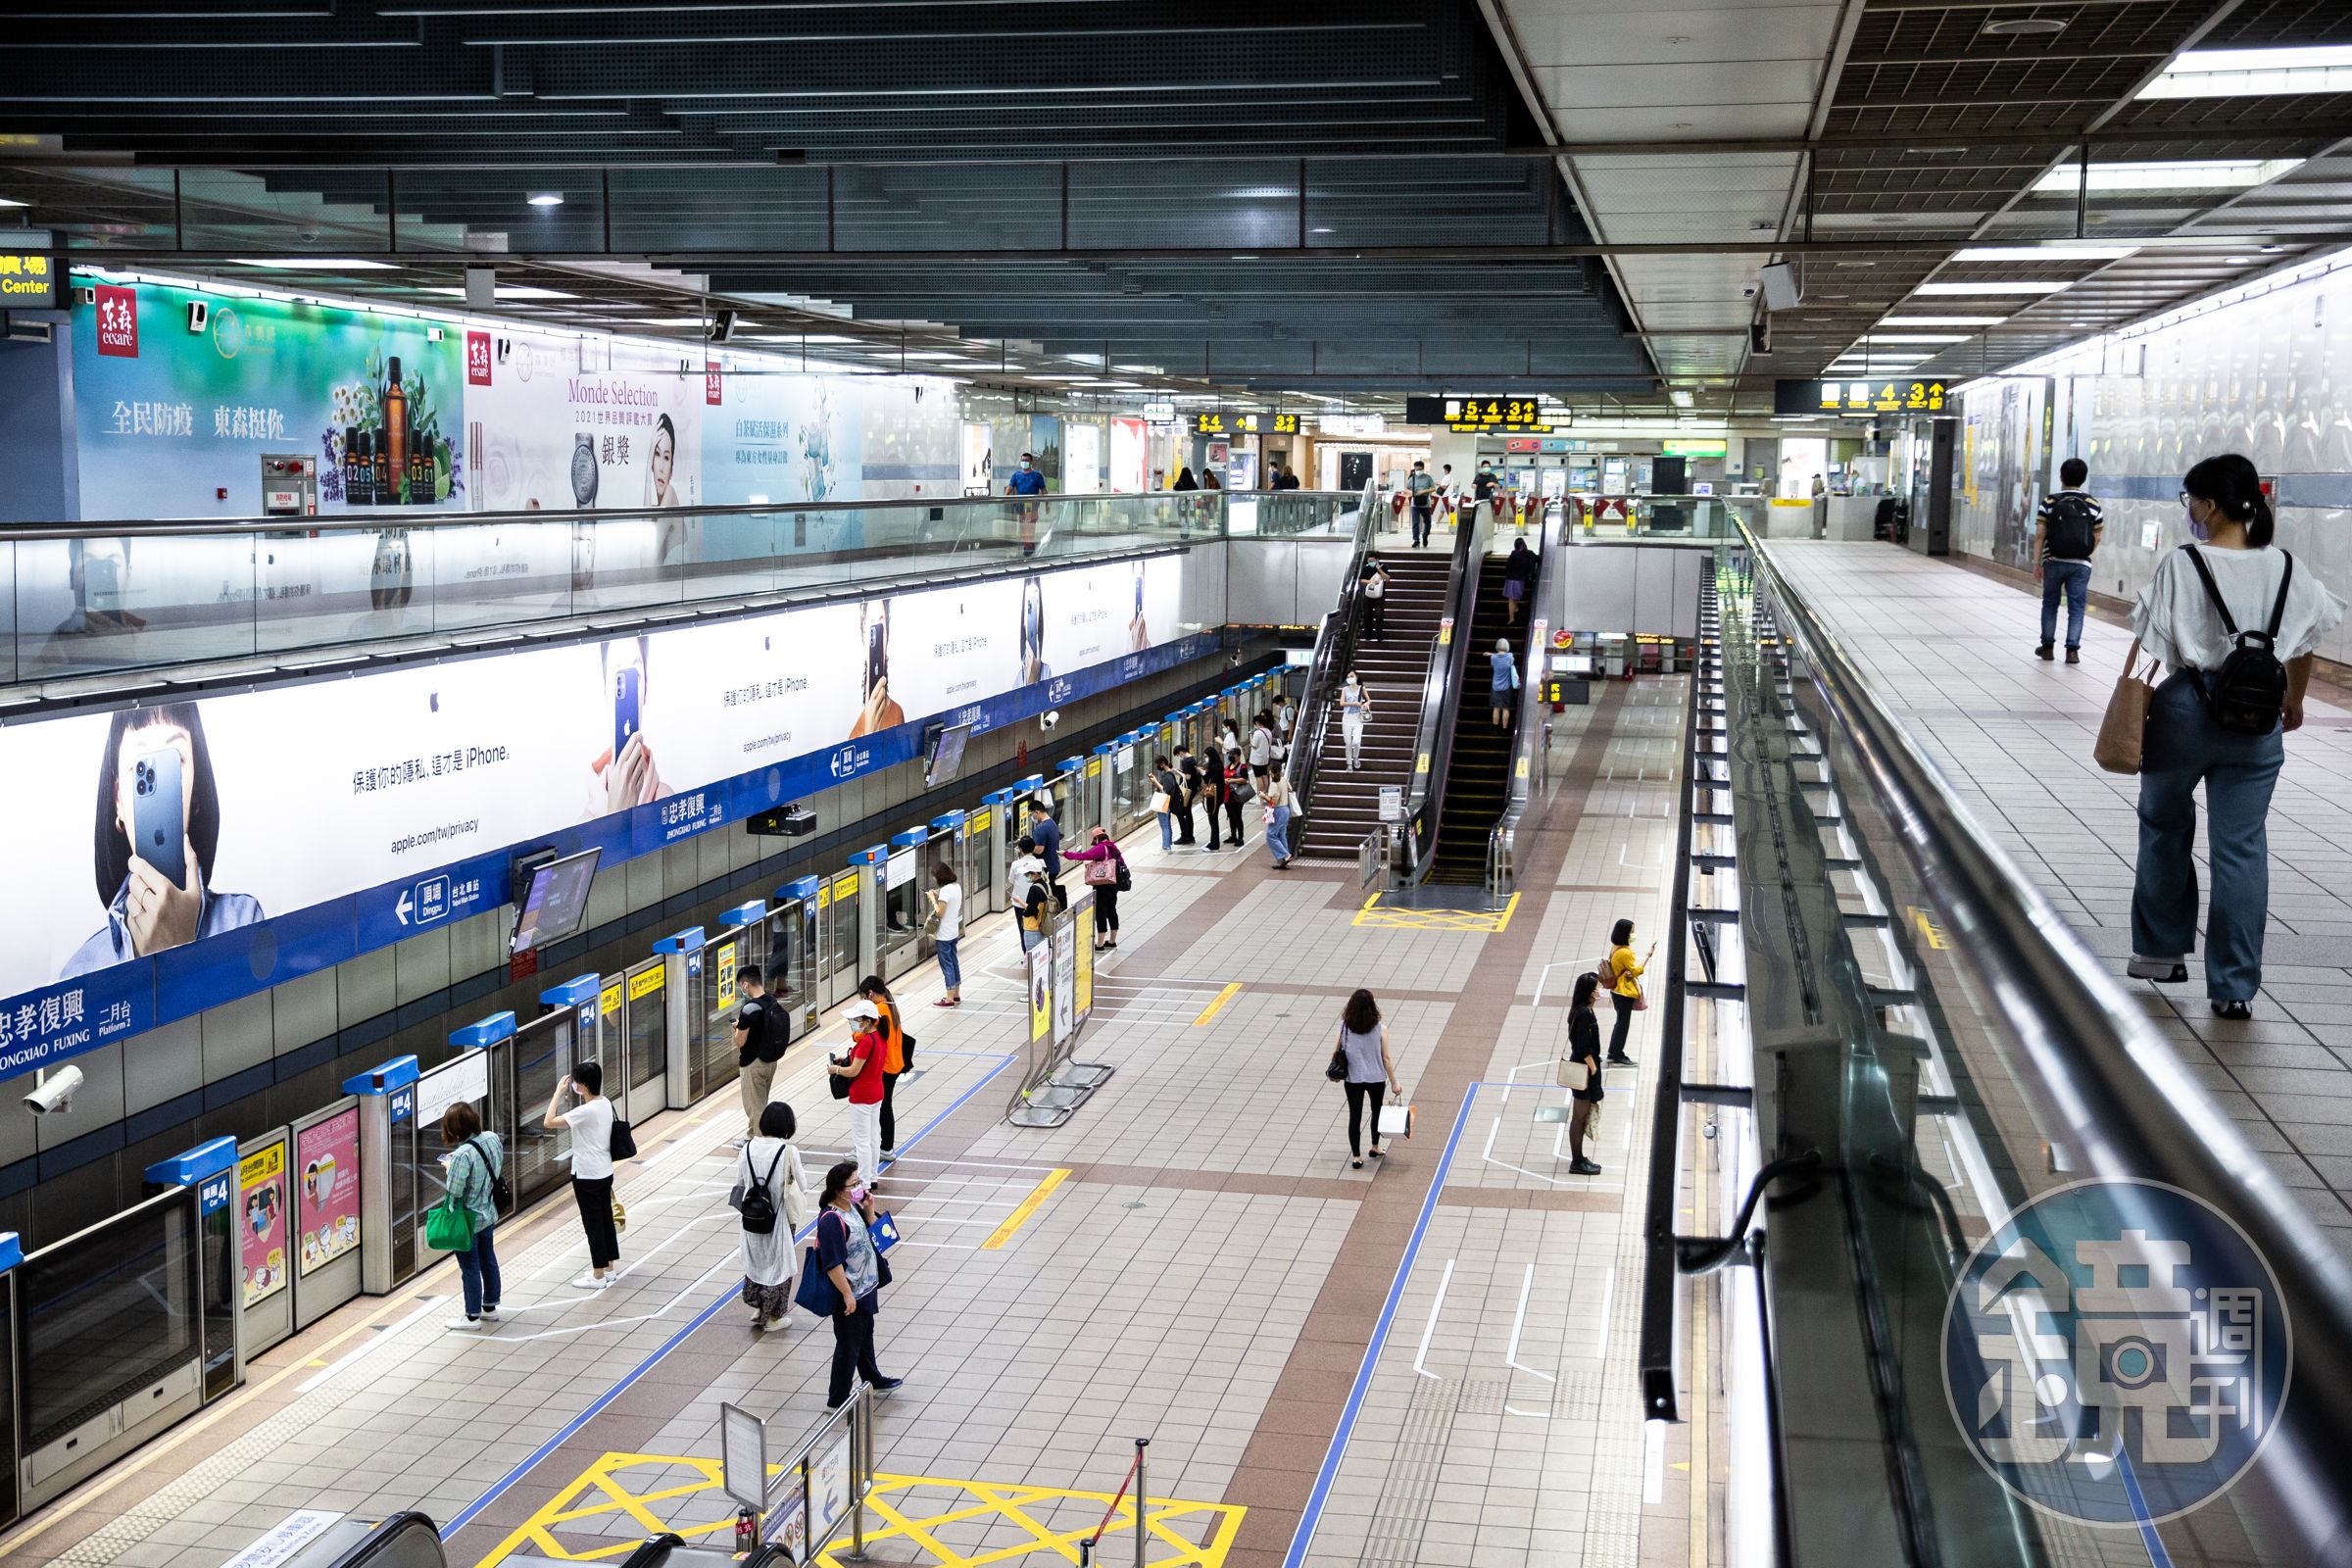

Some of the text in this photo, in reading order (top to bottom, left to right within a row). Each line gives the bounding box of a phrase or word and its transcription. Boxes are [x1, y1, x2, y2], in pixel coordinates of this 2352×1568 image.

[2, 279, 49, 293] Center
[568, 378, 659, 407] Monde Selection
[1881, 383, 1925, 401] 4 3
[1467, 402, 1520, 416] 5 4 3
[106, 400, 290, 440] 全民防疫 東森挺你
[602, 434, 629, 466] 銀獎
[347, 466, 359, 481] 02
[360, 467, 370, 482] 05
[412, 466, 422, 481] 03
[424, 468, 433, 482] 01
[668, 793, 705, 823] 忠孝復興
[391, 817, 479, 855] apple.com/tw/privacy
[422, 905, 442, 916] Dingpu
[99, 1001, 131, 1025] 二月台
[589, 1004, 595, 1020] 4
[99, 1018, 131, 1037] Platform 2
[54, 1029, 90, 1053] FUXING
[404, 1093, 411, 1110] 4
[219, 1180, 228, 1201] 4
[210, 1199, 219, 1207] Car
